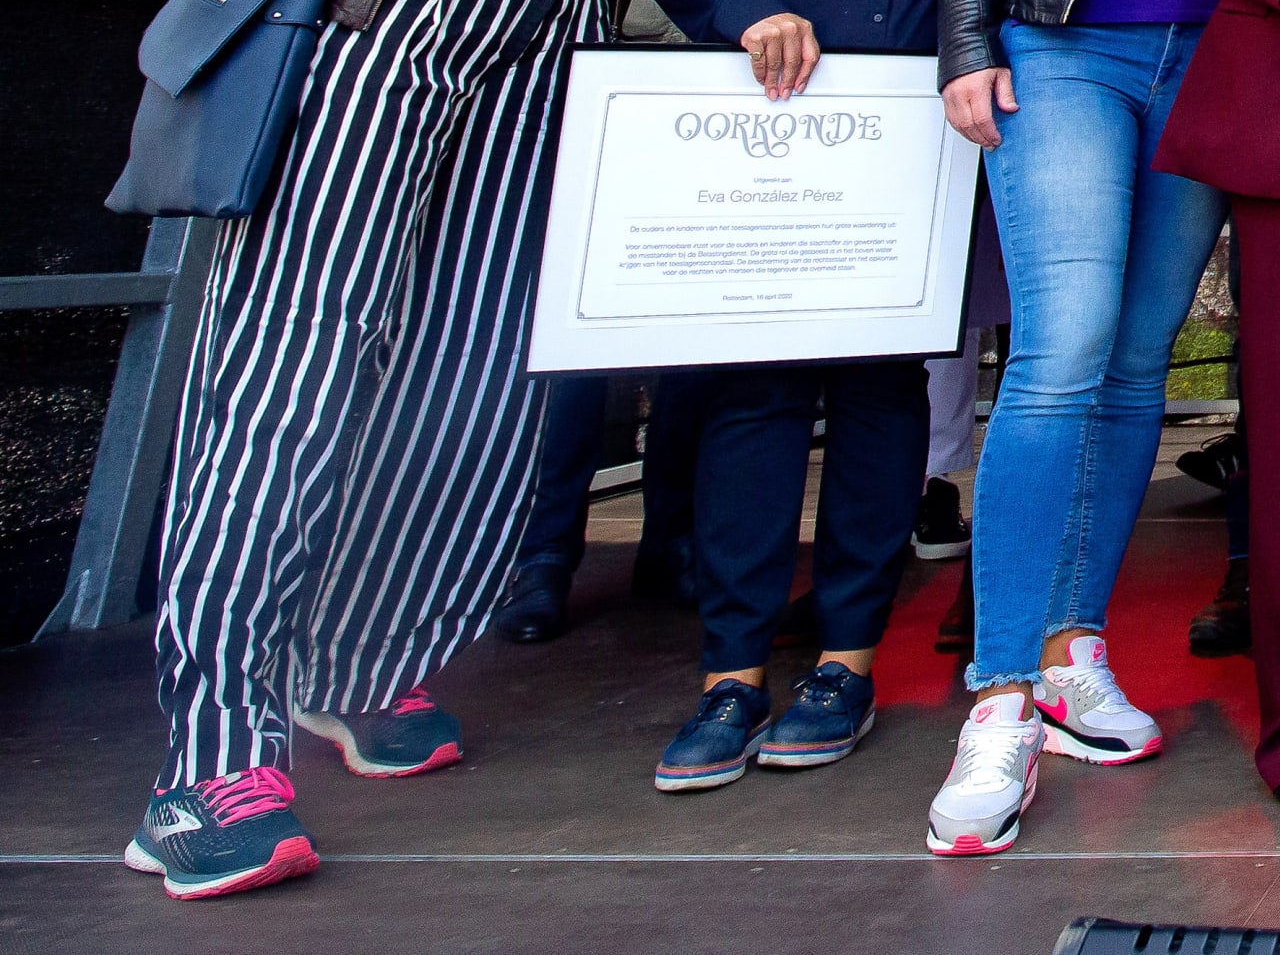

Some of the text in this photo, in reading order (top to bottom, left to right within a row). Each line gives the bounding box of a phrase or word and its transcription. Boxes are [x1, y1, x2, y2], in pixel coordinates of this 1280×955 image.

[674, 112, 882, 158] OORKONDE
[698, 188, 844, 203] Eva González Pérez
